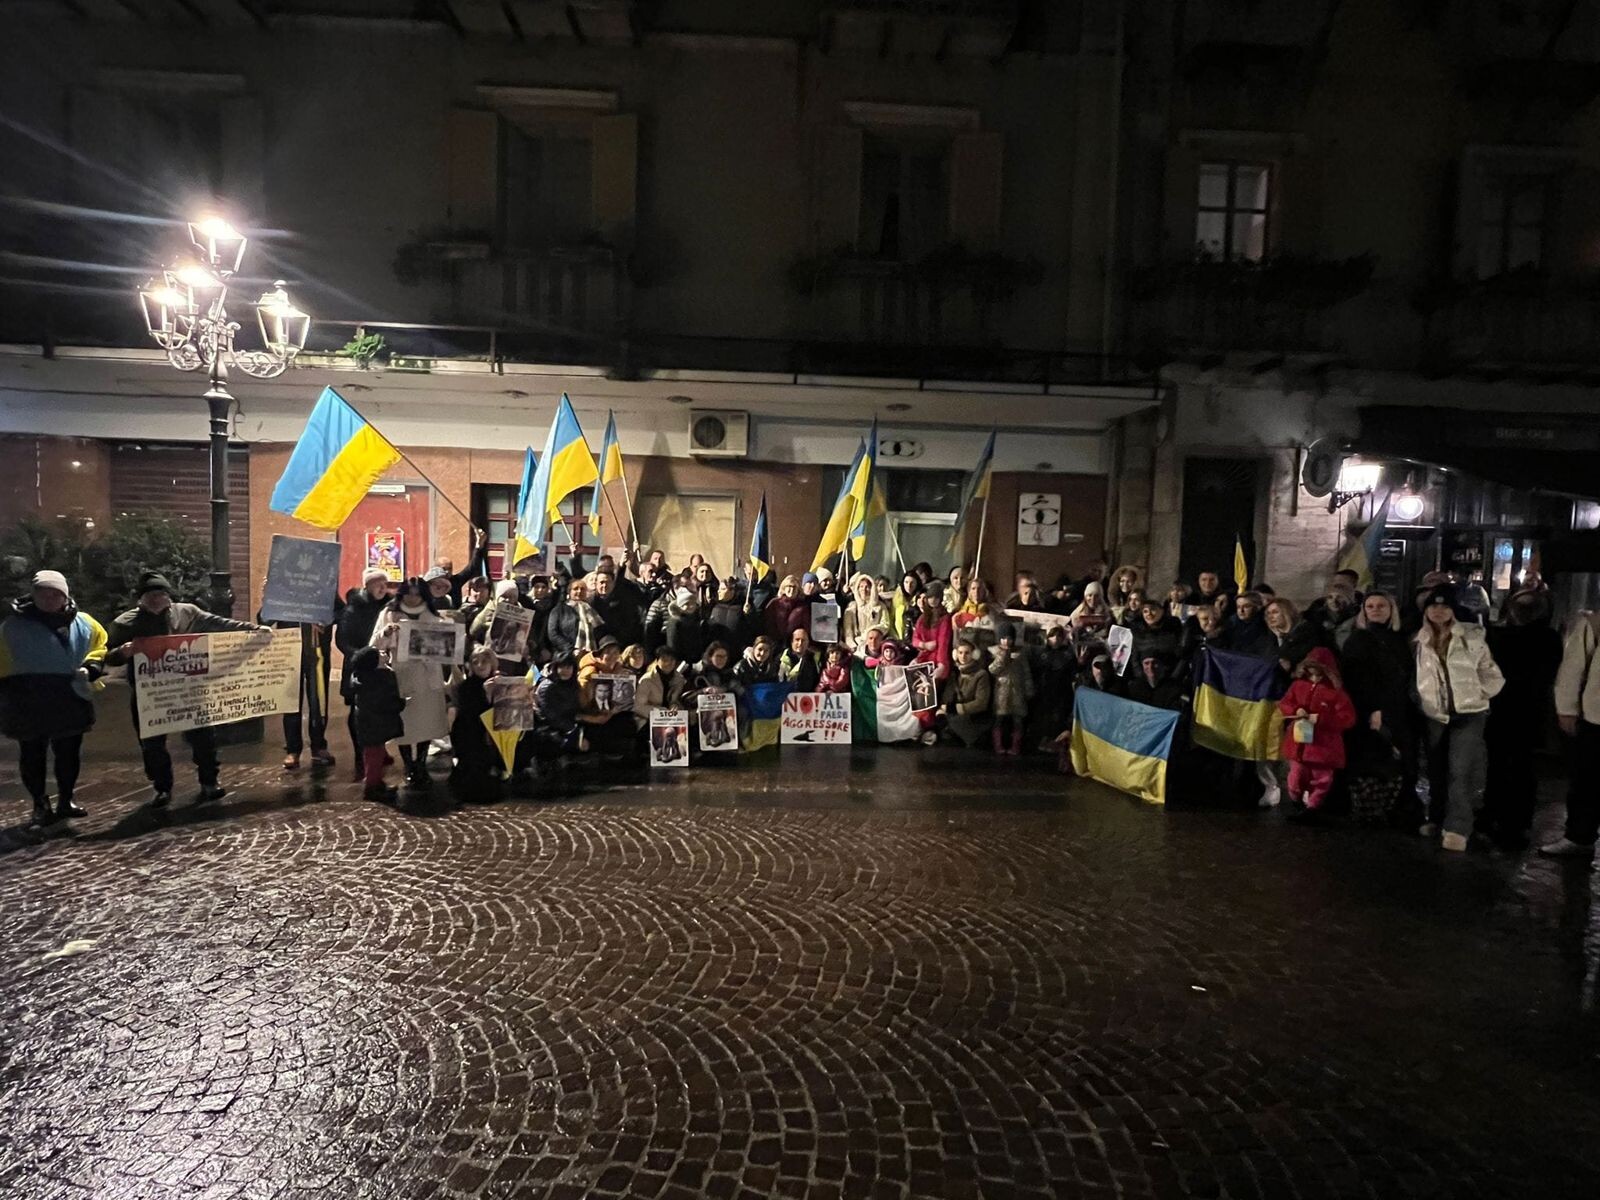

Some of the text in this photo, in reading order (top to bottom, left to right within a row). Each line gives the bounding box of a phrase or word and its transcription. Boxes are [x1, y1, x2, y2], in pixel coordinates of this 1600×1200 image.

[784, 694, 844, 714] NO! AL
[148, 713, 192, 727] CULTURA
[230, 704, 241, 712] TU
[820, 711, 849, 719] PAESE
[783, 717, 850, 732] AGGRESSORE
